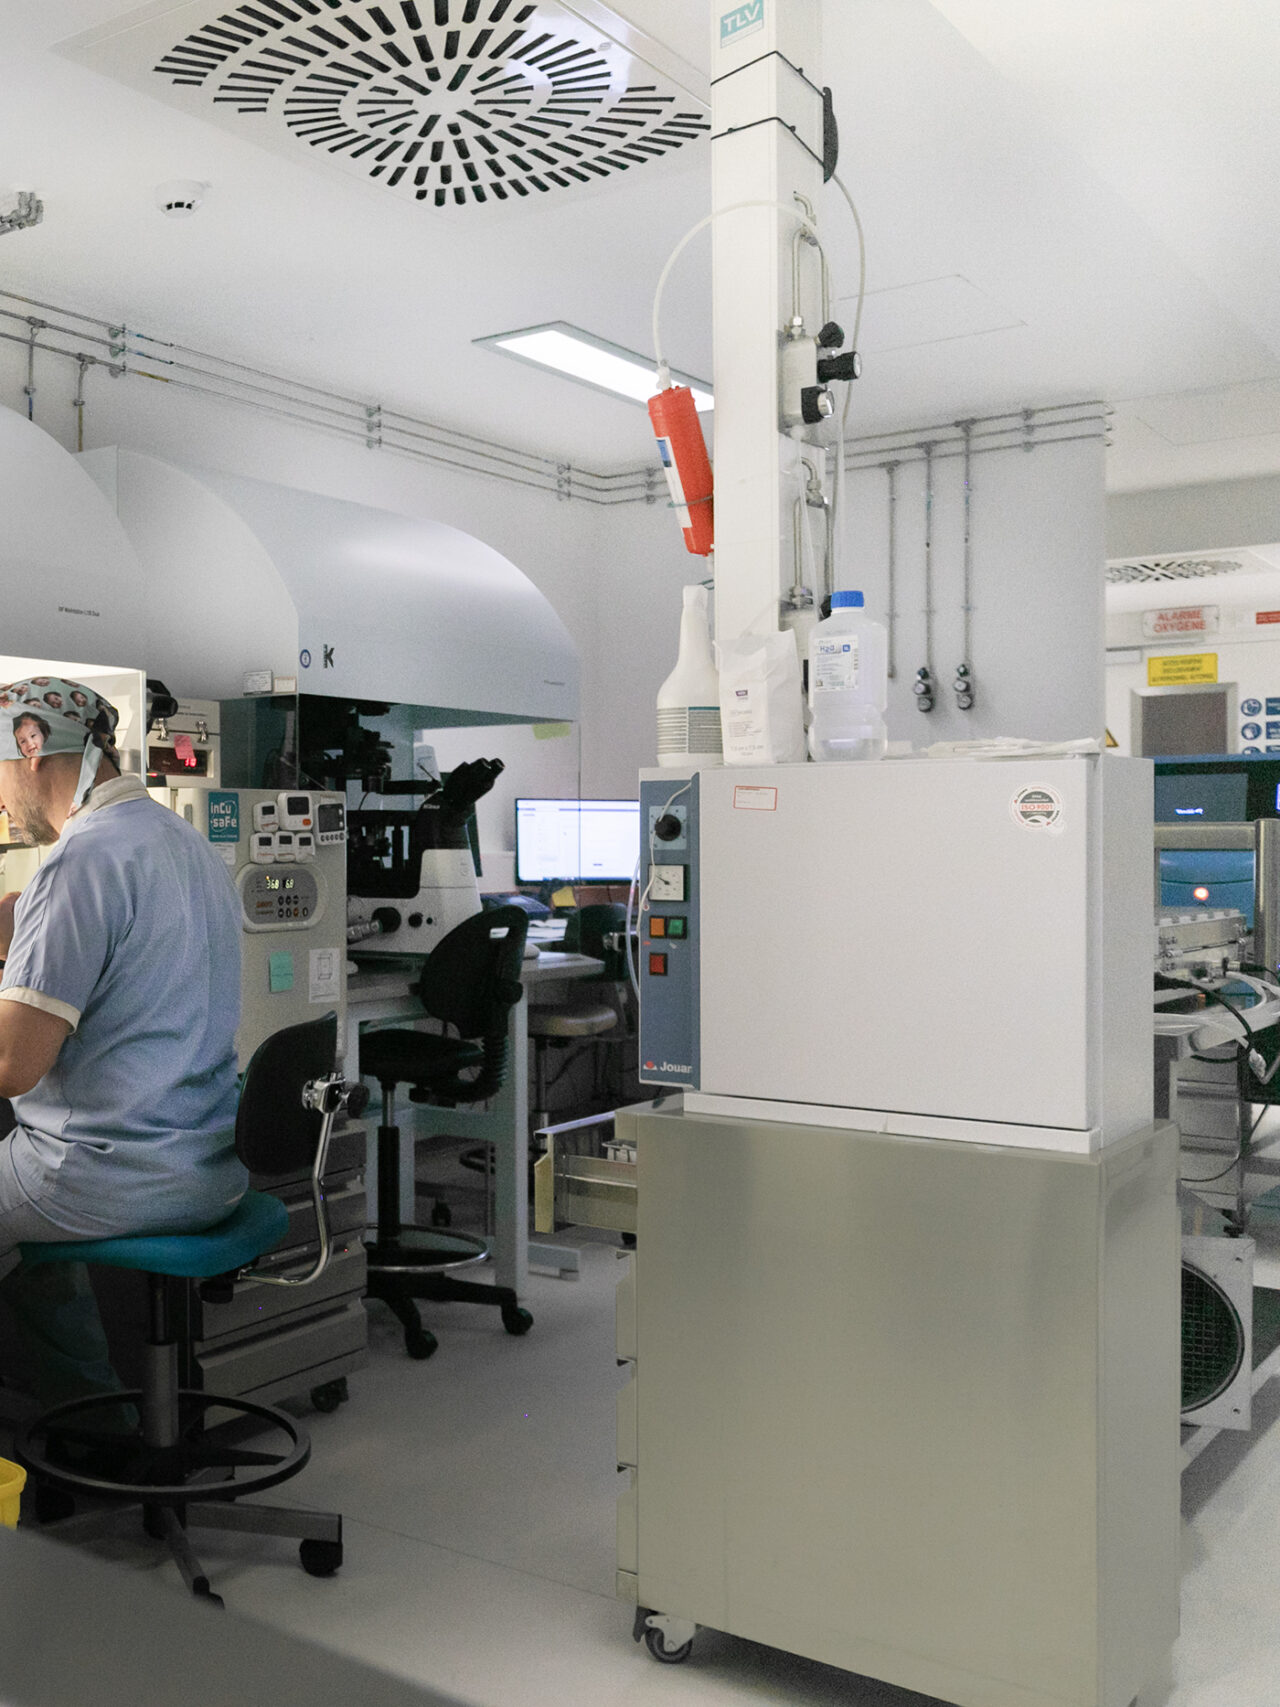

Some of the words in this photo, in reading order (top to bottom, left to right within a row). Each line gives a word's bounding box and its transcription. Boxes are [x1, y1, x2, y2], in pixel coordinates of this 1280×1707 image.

[723, 3, 760, 31] TLV
[1157, 609, 1202, 622] ALARME
[1153, 620, 1206, 633] OXYGENE
